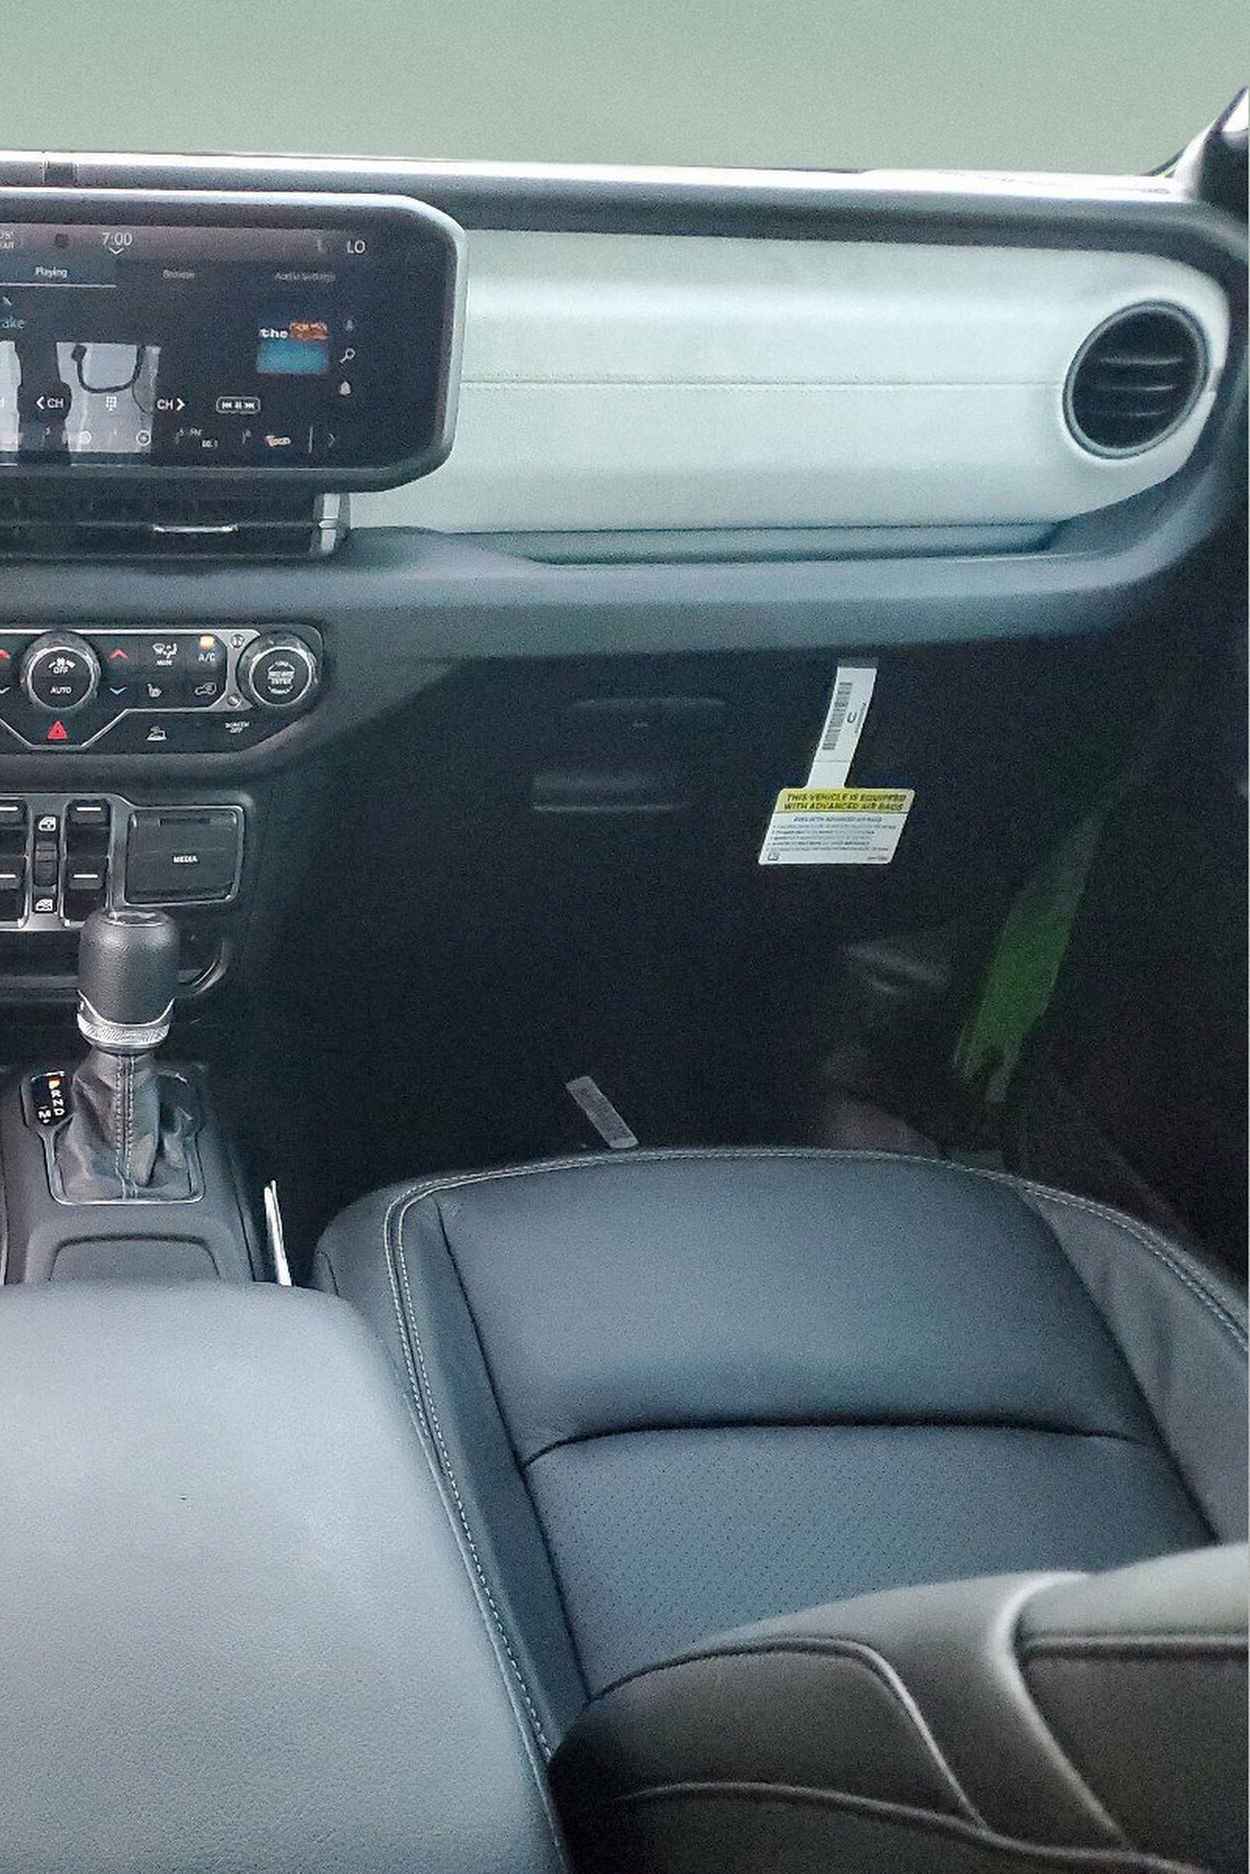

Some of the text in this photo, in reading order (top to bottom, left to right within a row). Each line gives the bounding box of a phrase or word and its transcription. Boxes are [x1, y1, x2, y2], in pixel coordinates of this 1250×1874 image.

[102, 232, 132, 245] 7:00
[347, 240, 365, 253] LO
[35, 267, 68, 278] Playing
[47, 398, 63, 409] CH
[157, 399, 173, 410] CH
[198, 652, 216, 662] A/C
[53, 666, 68, 675] OFF
[50, 686, 72, 695] AUTO
[859, 794, 907, 802] EQUIPPED
[861, 803, 877, 811] AIR
[51, 1089, 62, 1099] R
[52, 1099, 64, 1107] N
[38, 1110, 52, 1119] M
[53, 1108, 65, 1116] D
